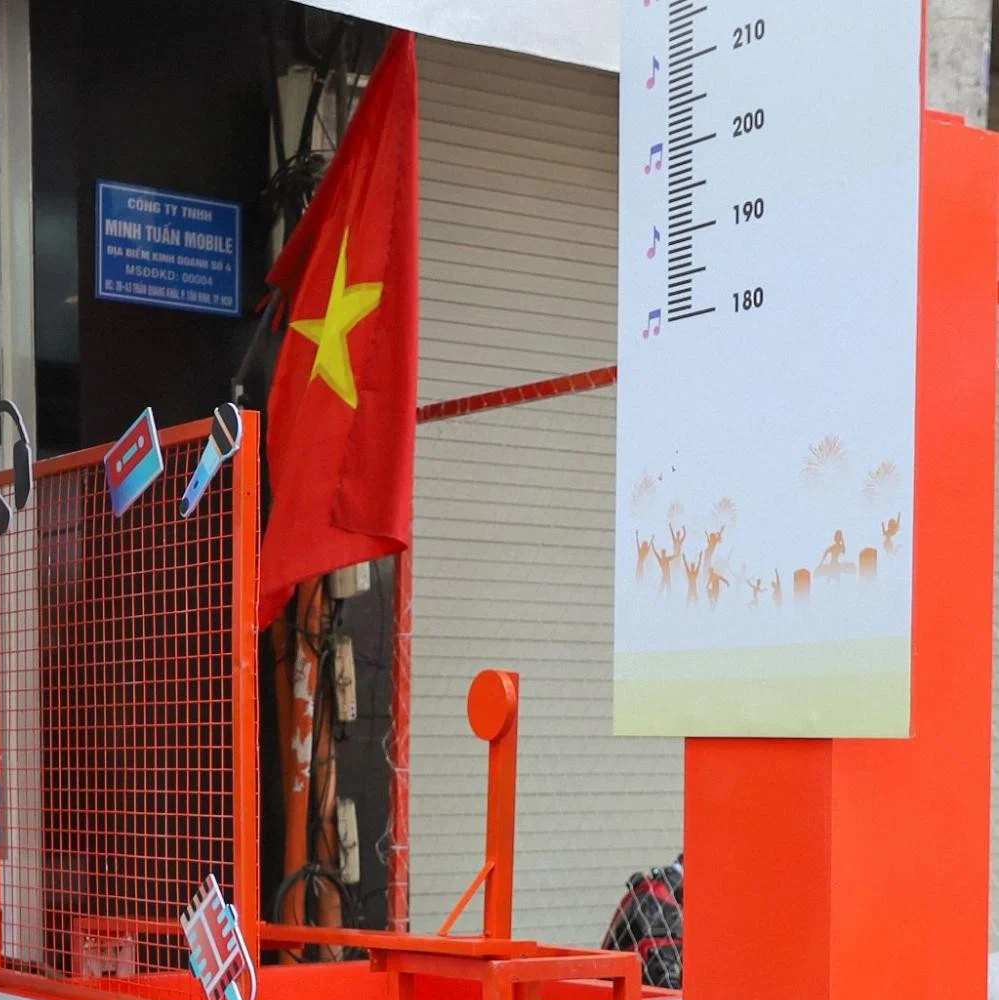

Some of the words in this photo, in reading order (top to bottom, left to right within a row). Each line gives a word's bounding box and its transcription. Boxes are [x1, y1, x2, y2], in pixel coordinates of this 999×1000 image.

[732, 19, 765, 49] 210
[732, 109, 765, 138] 200
[165, 204, 178, 217] TY
[732, 198, 765, 226] 190
[104, 218, 142, 241] MINH
[145, 222, 181, 247] TUẤN
[183, 230, 233, 254] MOBILE
[732, 286, 764, 314] 180
